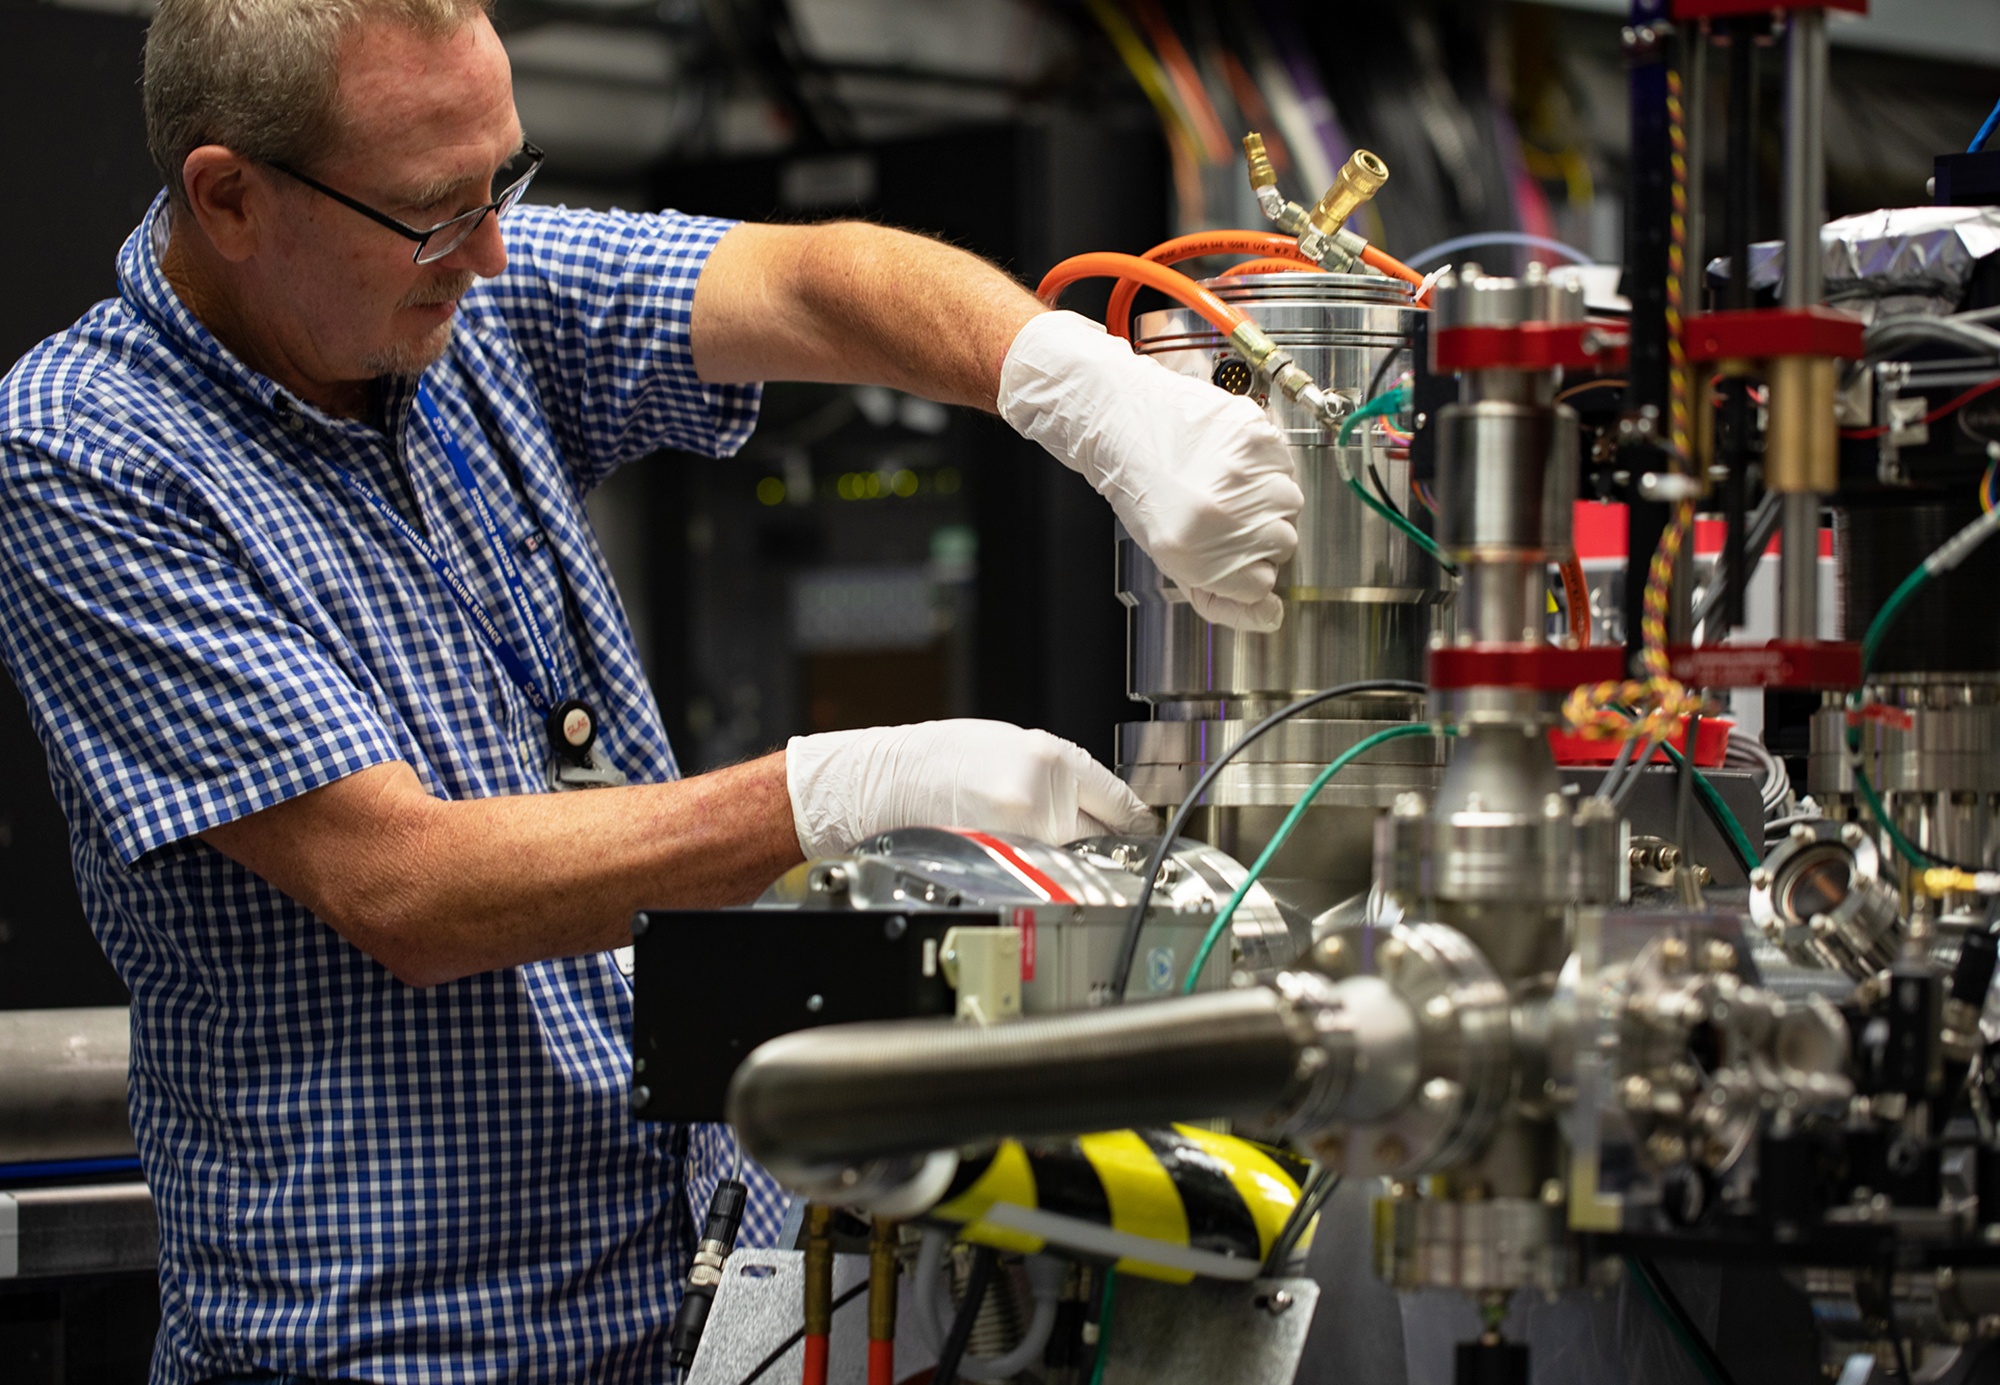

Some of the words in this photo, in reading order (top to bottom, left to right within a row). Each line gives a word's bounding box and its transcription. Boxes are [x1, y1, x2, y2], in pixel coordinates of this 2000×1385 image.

[470, 487, 497, 536] SCIENCE
[380, 503, 439, 563] SUSTAINABLE
[442, 566, 473, 606] SECURE
[472, 604, 503, 647] SCIENCE
[492, 534, 517, 580] SECURE
[514, 585, 550, 661] SUSTAINABLE
